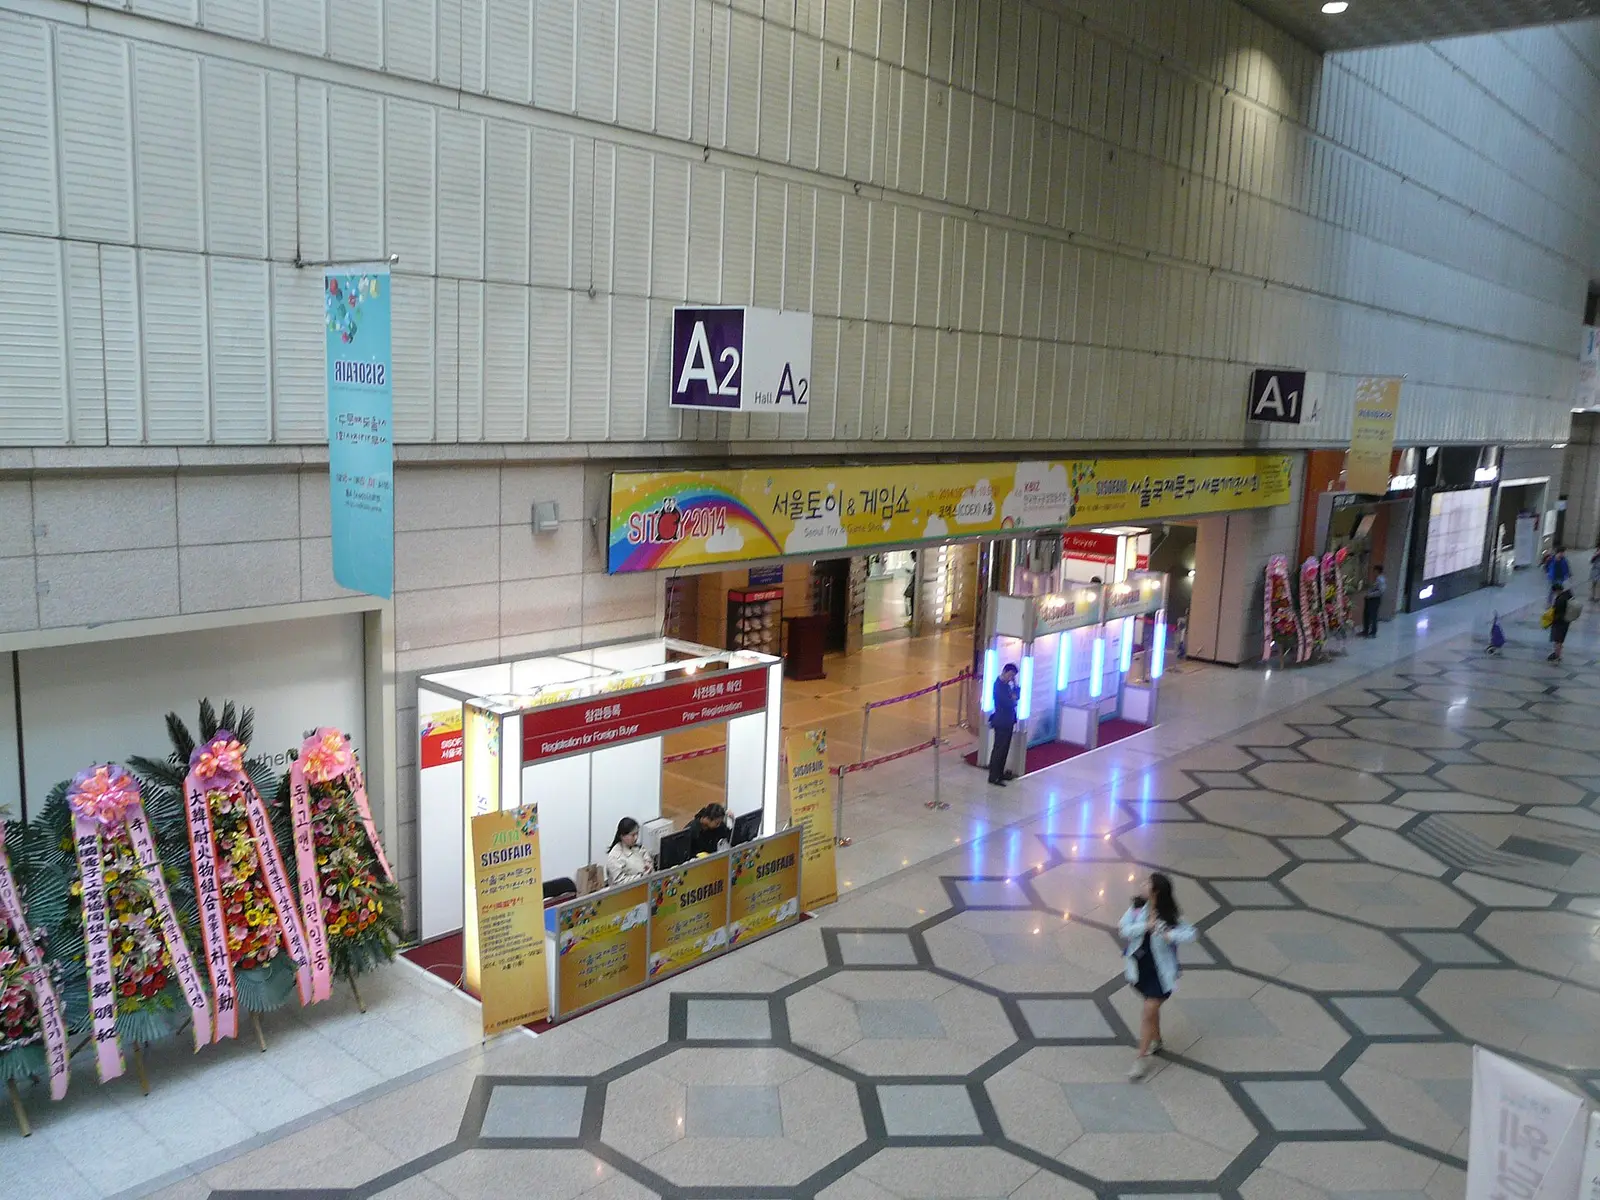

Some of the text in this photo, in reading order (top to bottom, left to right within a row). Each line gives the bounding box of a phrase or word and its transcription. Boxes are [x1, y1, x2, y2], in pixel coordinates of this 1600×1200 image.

[676, 320, 740, 396] A2
[754, 361, 808, 405] Hall A2
[1255, 375, 1299, 417] A1
[772, 489, 843, 521] 서울토이
[859, 485, 912, 521] 게임쇼
[690, 505, 728, 538] 2014
[724, 679, 743, 693] 확인
[701, 700, 743, 719] Registration
[541, 723, 639, 754] Registration for Foreign Buyer
[481, 843, 533, 867] SISOFAIR
[756, 852, 795, 880] SISOFAIR
[680, 879, 724, 909] SISOFAIR
